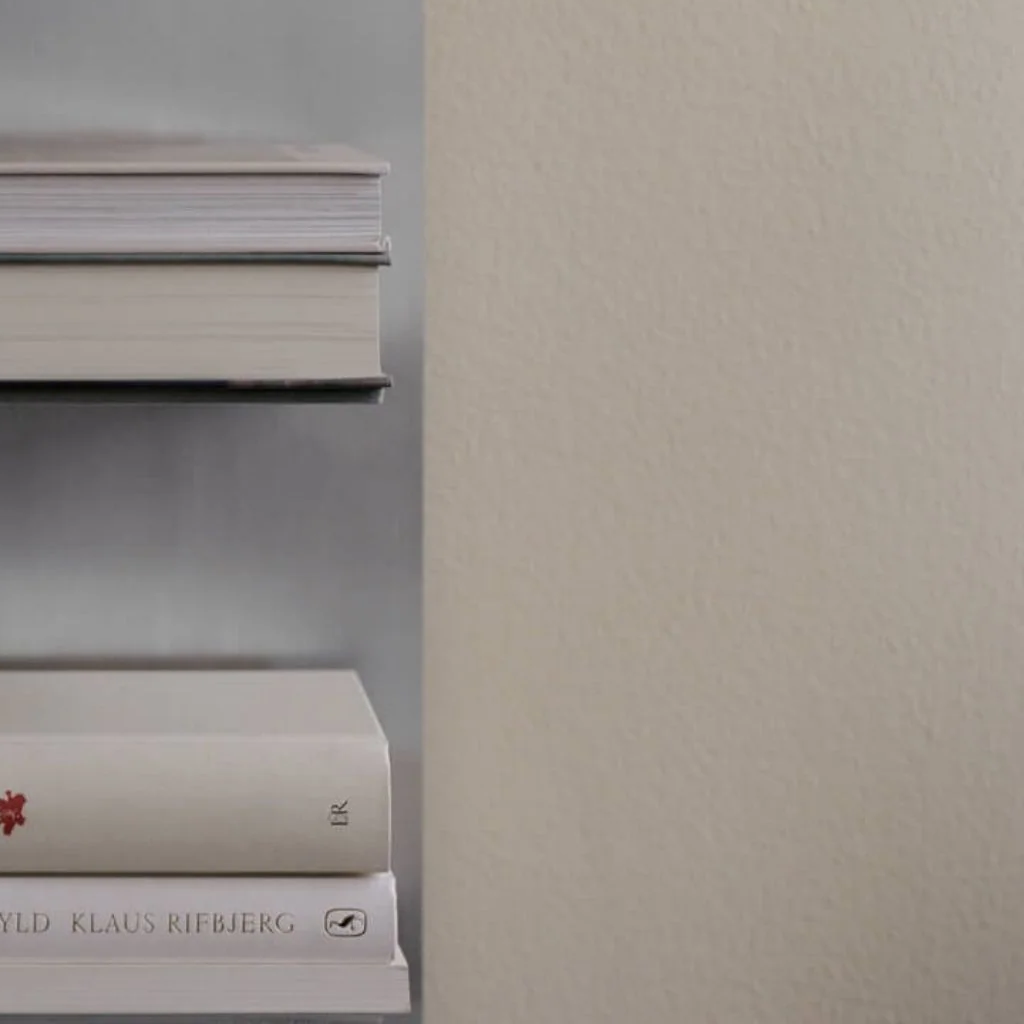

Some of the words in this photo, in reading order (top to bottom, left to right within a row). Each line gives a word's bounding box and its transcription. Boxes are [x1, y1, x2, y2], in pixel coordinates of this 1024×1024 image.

[329, 799, 349, 827] ER
[71, 911, 156, 934] KLAUS
[167, 911, 296, 935] RIFBJERG
